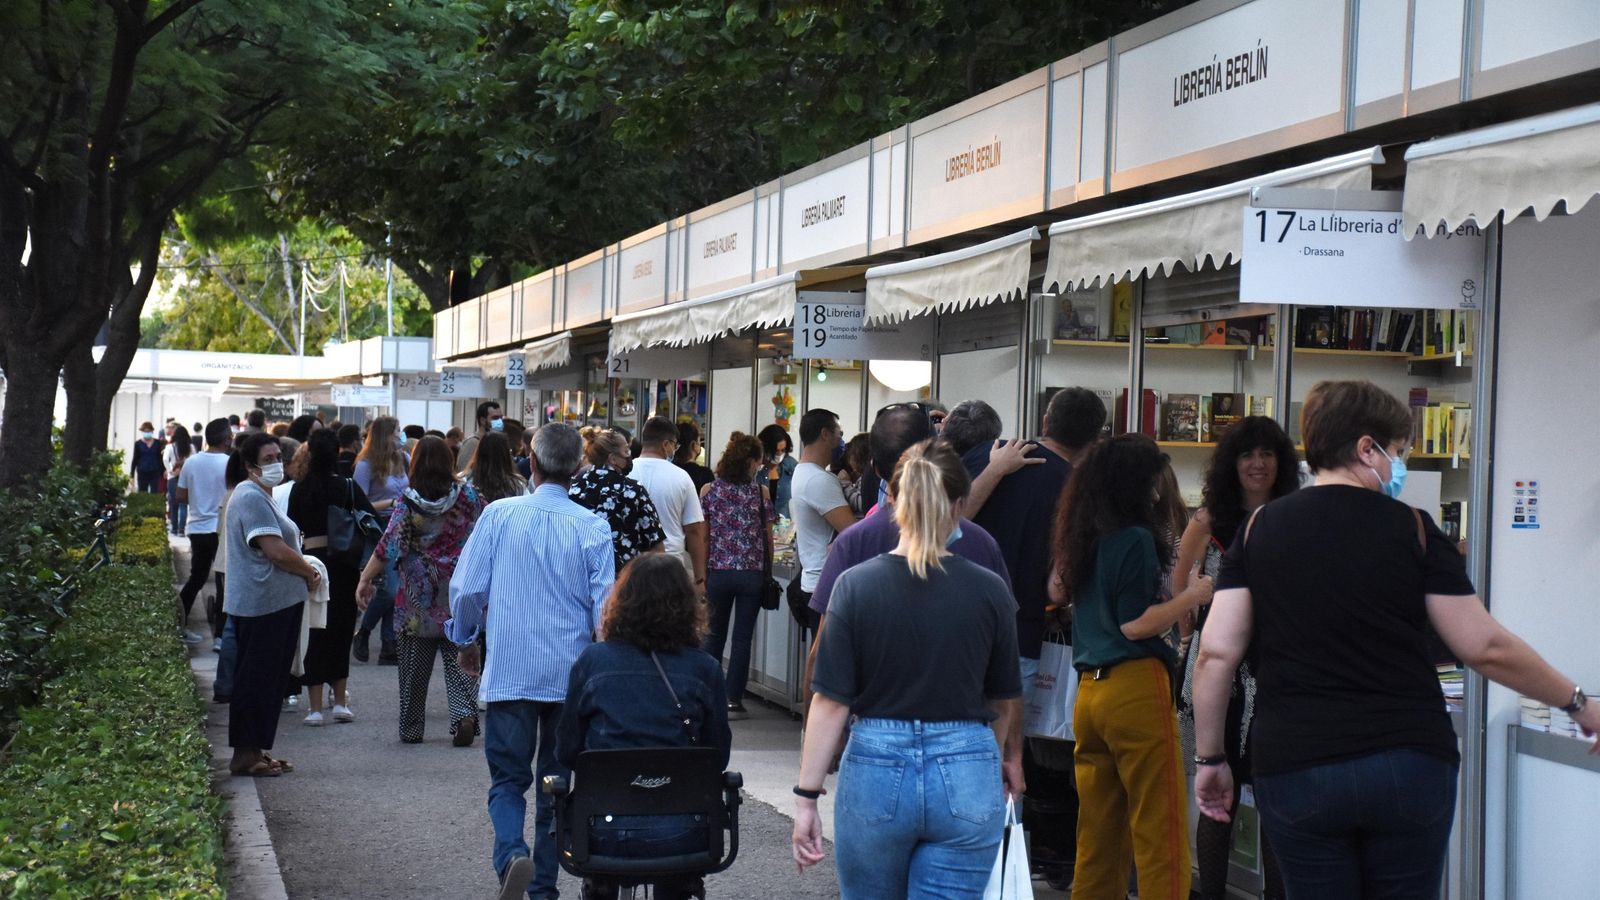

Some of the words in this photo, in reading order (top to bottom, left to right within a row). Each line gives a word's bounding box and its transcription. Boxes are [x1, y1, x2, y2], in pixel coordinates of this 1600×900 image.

[1174, 54, 1222, 107] LIBRERÍA
[1226, 38, 1268, 90] BERLÍN
[945, 144, 974, 182] LIBRERÍA
[976, 135, 1001, 172] BERLÍN
[801, 200, 821, 228] LIBRERÍA
[821, 195, 846, 221] PALMARET
[1255, 209, 1297, 243] 17
[1299, 216, 1316, 232] La
[1321, 215, 1383, 233] Llibreria
[1303, 246, 1345, 257] Drassana
[802, 304, 826, 325] 18
[829, 325, 850, 333] Tiempo
[802, 328, 826, 348] 19
[829, 333, 858, 341] Acantilado
[508, 359, 524, 371] 22
[613, 358, 629, 373] 21
[417, 376, 430, 386] 26
[442, 371, 455, 381] 24
[508, 374, 524, 386] 23
[399, 379, 410, 388] 27
[442, 384, 455, 394] 25
